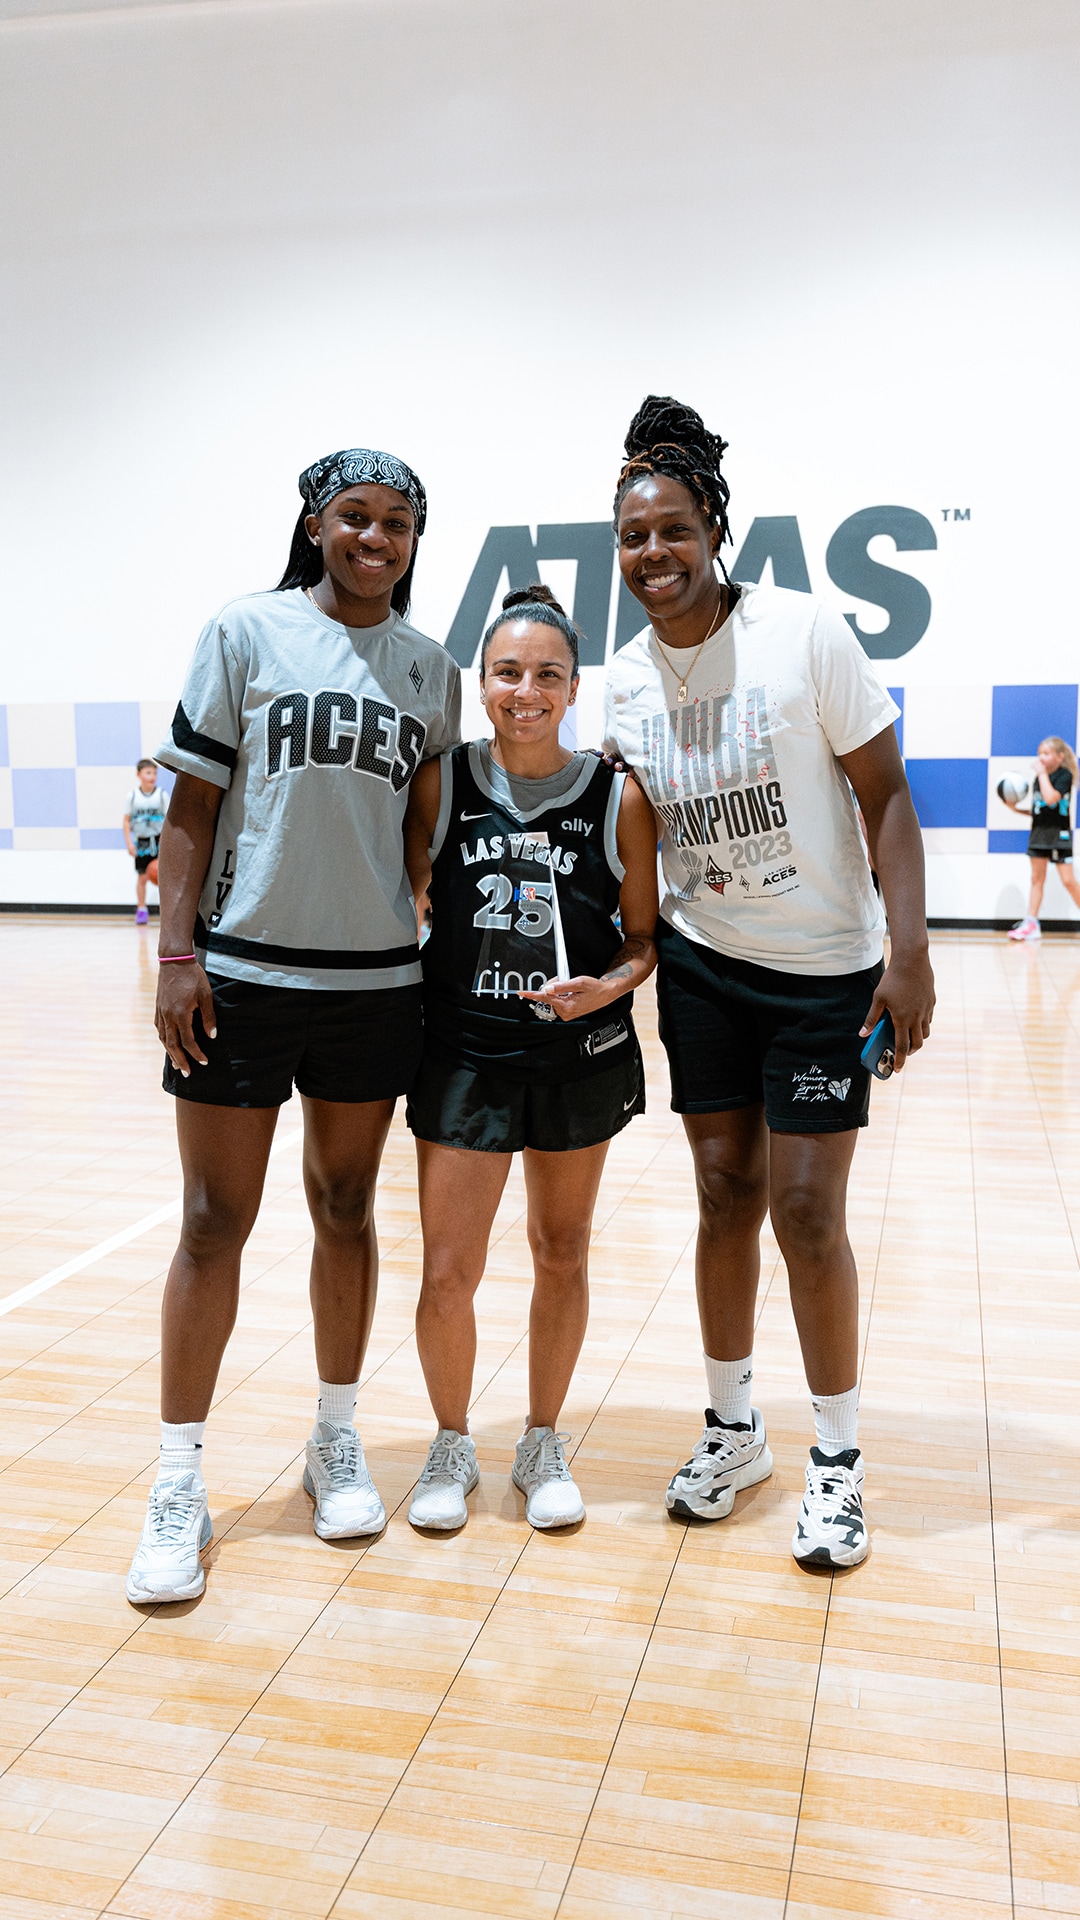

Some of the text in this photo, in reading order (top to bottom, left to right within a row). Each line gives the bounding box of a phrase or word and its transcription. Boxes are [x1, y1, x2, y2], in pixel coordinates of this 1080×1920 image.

[941, 508, 971, 521] TM
[265, 688, 428, 796] ACES
[641, 686, 779, 803] WNBA
[561, 818, 594, 837] ally
[460, 835, 579, 875] LAS VEGAS
[728, 830, 793, 869] 2023
[762, 866, 798, 887] ACES
[473, 873, 555, 937] 25
[810, 1092, 831, 1103] Me
